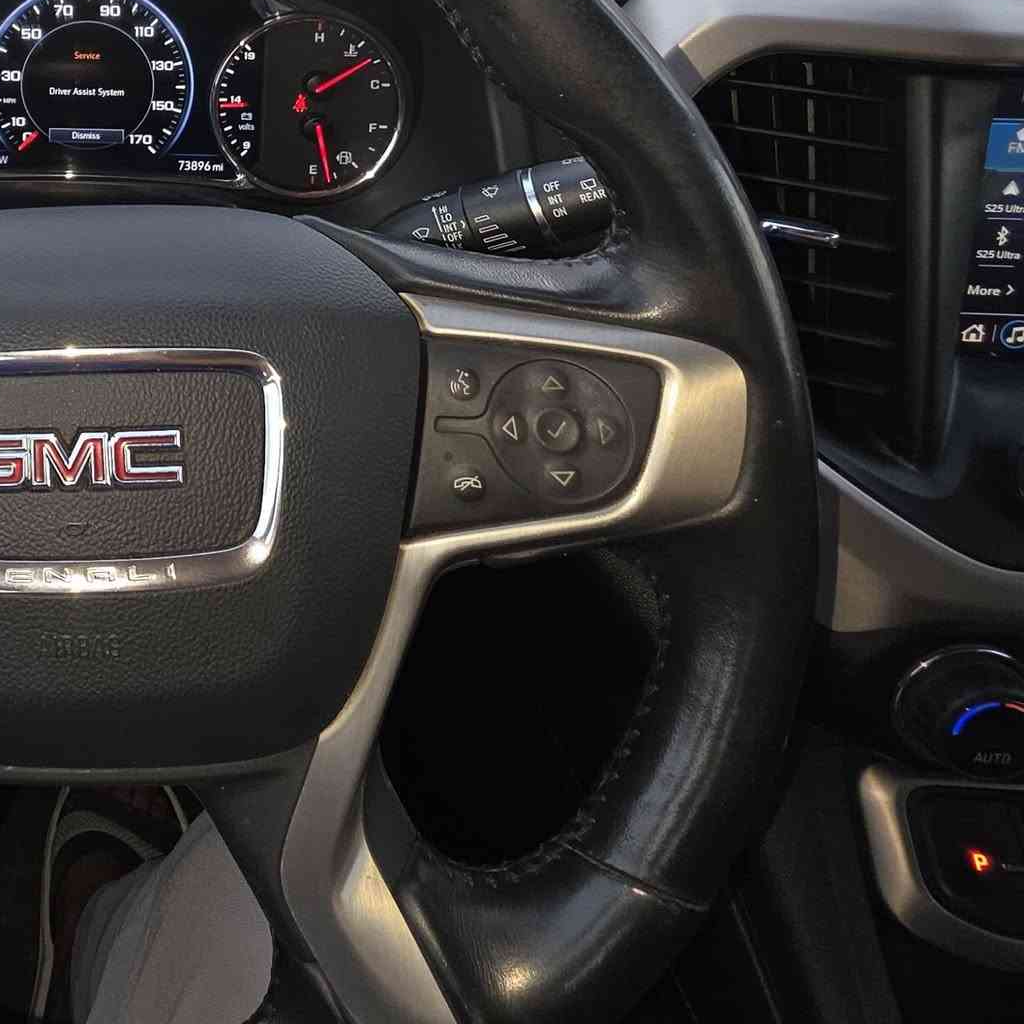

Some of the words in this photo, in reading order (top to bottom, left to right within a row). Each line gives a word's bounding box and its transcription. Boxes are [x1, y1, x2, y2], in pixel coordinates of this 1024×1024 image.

[54, 4, 73, 17] 70
[100, 4, 120, 17] 90
[21, 28, 42, 40] 50
[134, 26, 154, 38] 110
[314, 32, 325, 43] H
[74, 51, 101, 60] Service
[244, 52, 256, 61] 19
[152, 60, 174, 72] 130
[1, 70, 21, 82] 30
[370, 80, 380, 90] C
[49, 87, 71, 96] Driver
[72, 87, 96, 96] Assist
[98, 87, 125, 98] System
[230, 95, 241, 103] 14
[152, 100, 174, 111] 150
[11, 117, 26, 127] 10
[238, 123, 255, 131] volts
[368, 123, 377, 133] F
[71, 132, 101, 140] Dismiss
[129, 134, 153, 145] 170
[243, 141, 251, 150] 9
[178, 160, 211, 172] 73896
[212, 162, 224, 172] mi
[309, 164, 317, 175] E
[543, 180, 561, 193] OFF
[547, 194, 564, 206] INT
[579, 188, 608, 204] REAR
[438, 205, 448, 214] HI
[552, 207, 568, 218] ON
[984, 203, 1004, 213] S25
[1005, 203, 1024, 214] Ultr
[440, 213, 453, 224] LO
[442, 223, 458, 233] INT
[447, 232, 464, 242] OFF
[976, 249, 995, 259] S25
[996, 249, 1021, 260] Ultra
[967, 284, 1001, 297] More
[973, 751, 1012, 765] AUTO
[970, 849, 990, 872] P
